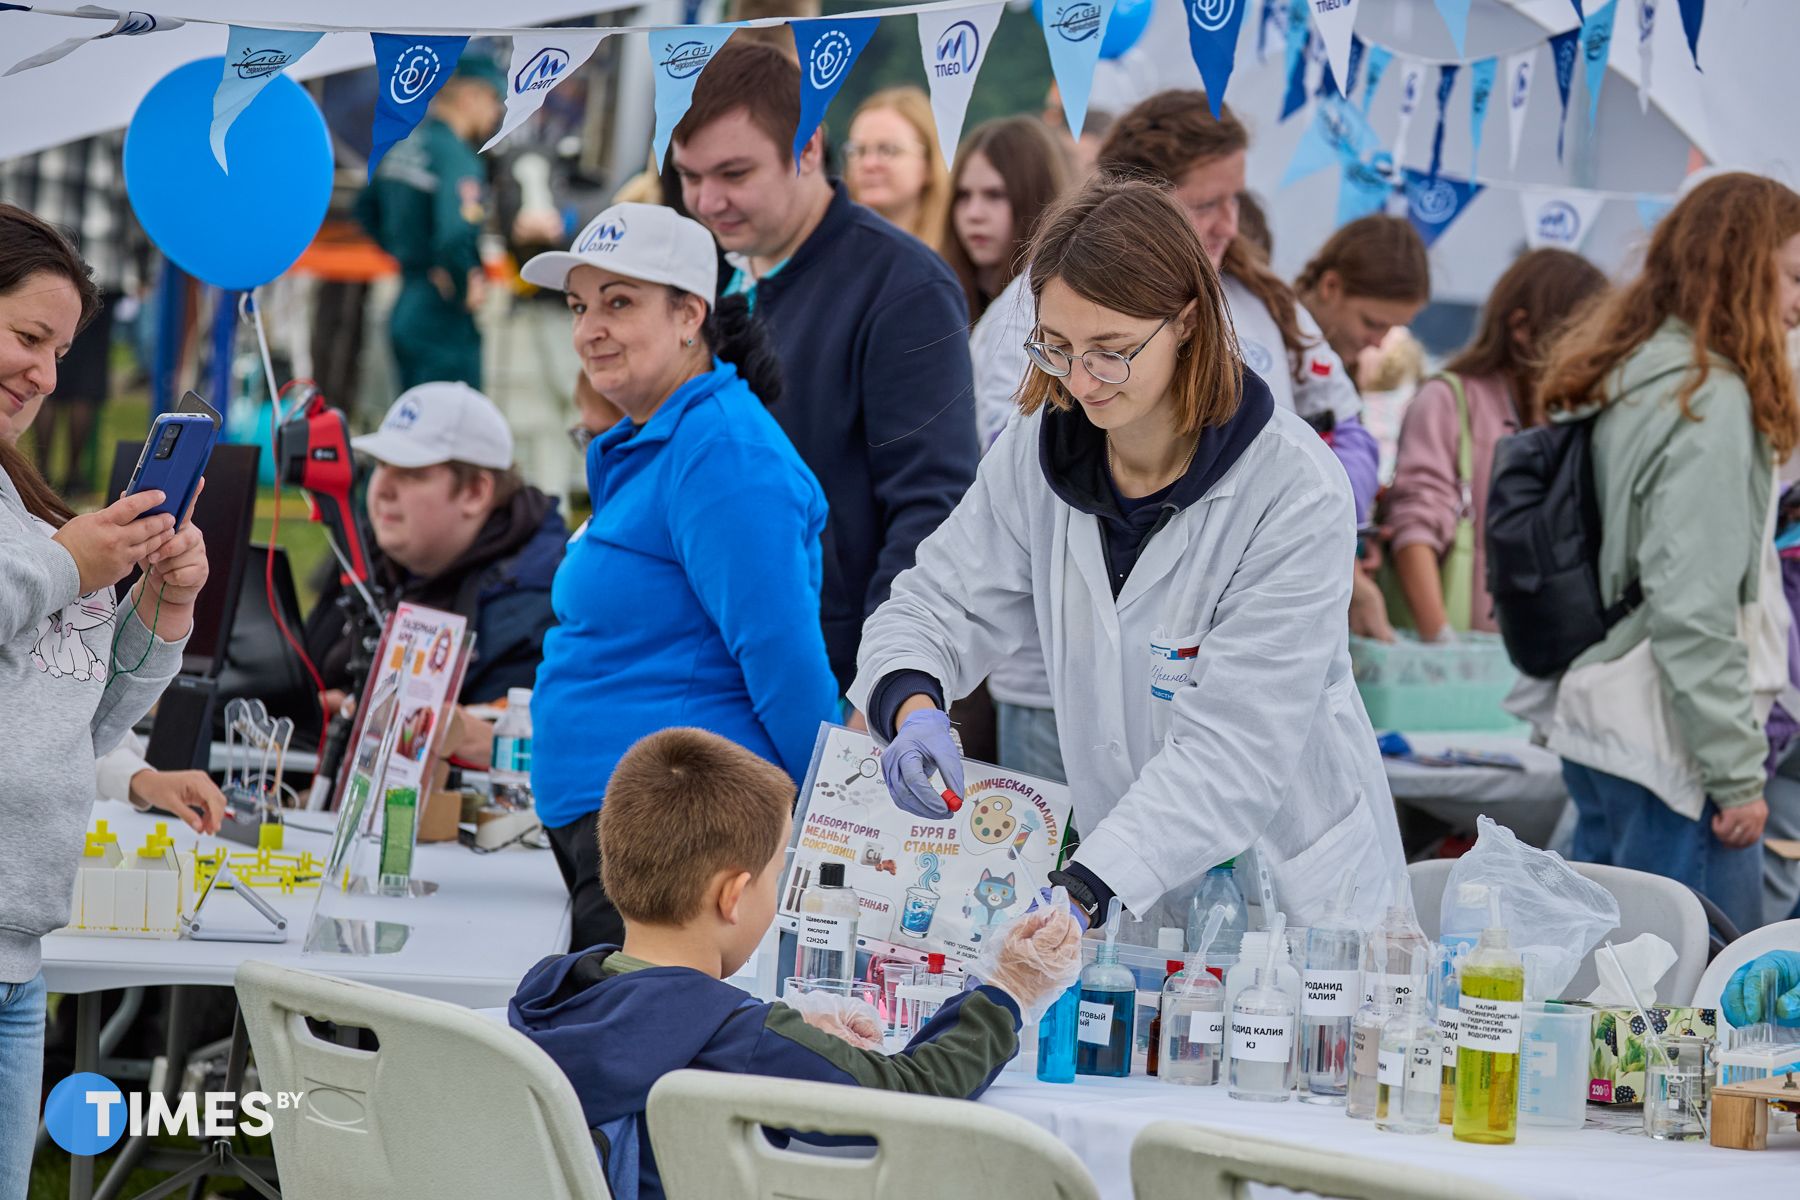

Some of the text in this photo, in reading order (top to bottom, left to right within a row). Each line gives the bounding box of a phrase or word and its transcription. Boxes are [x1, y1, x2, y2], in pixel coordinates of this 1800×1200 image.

[808, 812, 880, 840] ЛАБОРАТОРИЯ
[1032, 794, 1058, 846] ПАЛИТРА
[805, 825, 850, 845] МЕДНЫХ
[911, 826, 957, 840] БУРЯ В
[802, 836, 856, 861] СОКРОВИЩ
[904, 840, 960, 856] СТАКАНЕ
[858, 897, 889, 912] ЕННАЯ
[1305, 981, 1343, 991] РОДАНИД
[1308, 992, 1336, 1001] КАЛИЯ
[1468, 1016, 1504, 1027] ГИДРОКСИД
[1254, 1027, 1284, 1036] КАЛИЯ
[1468, 1031, 1501, 1041] ВОДОРОДА
[1592, 1084, 1603, 1095] 230
